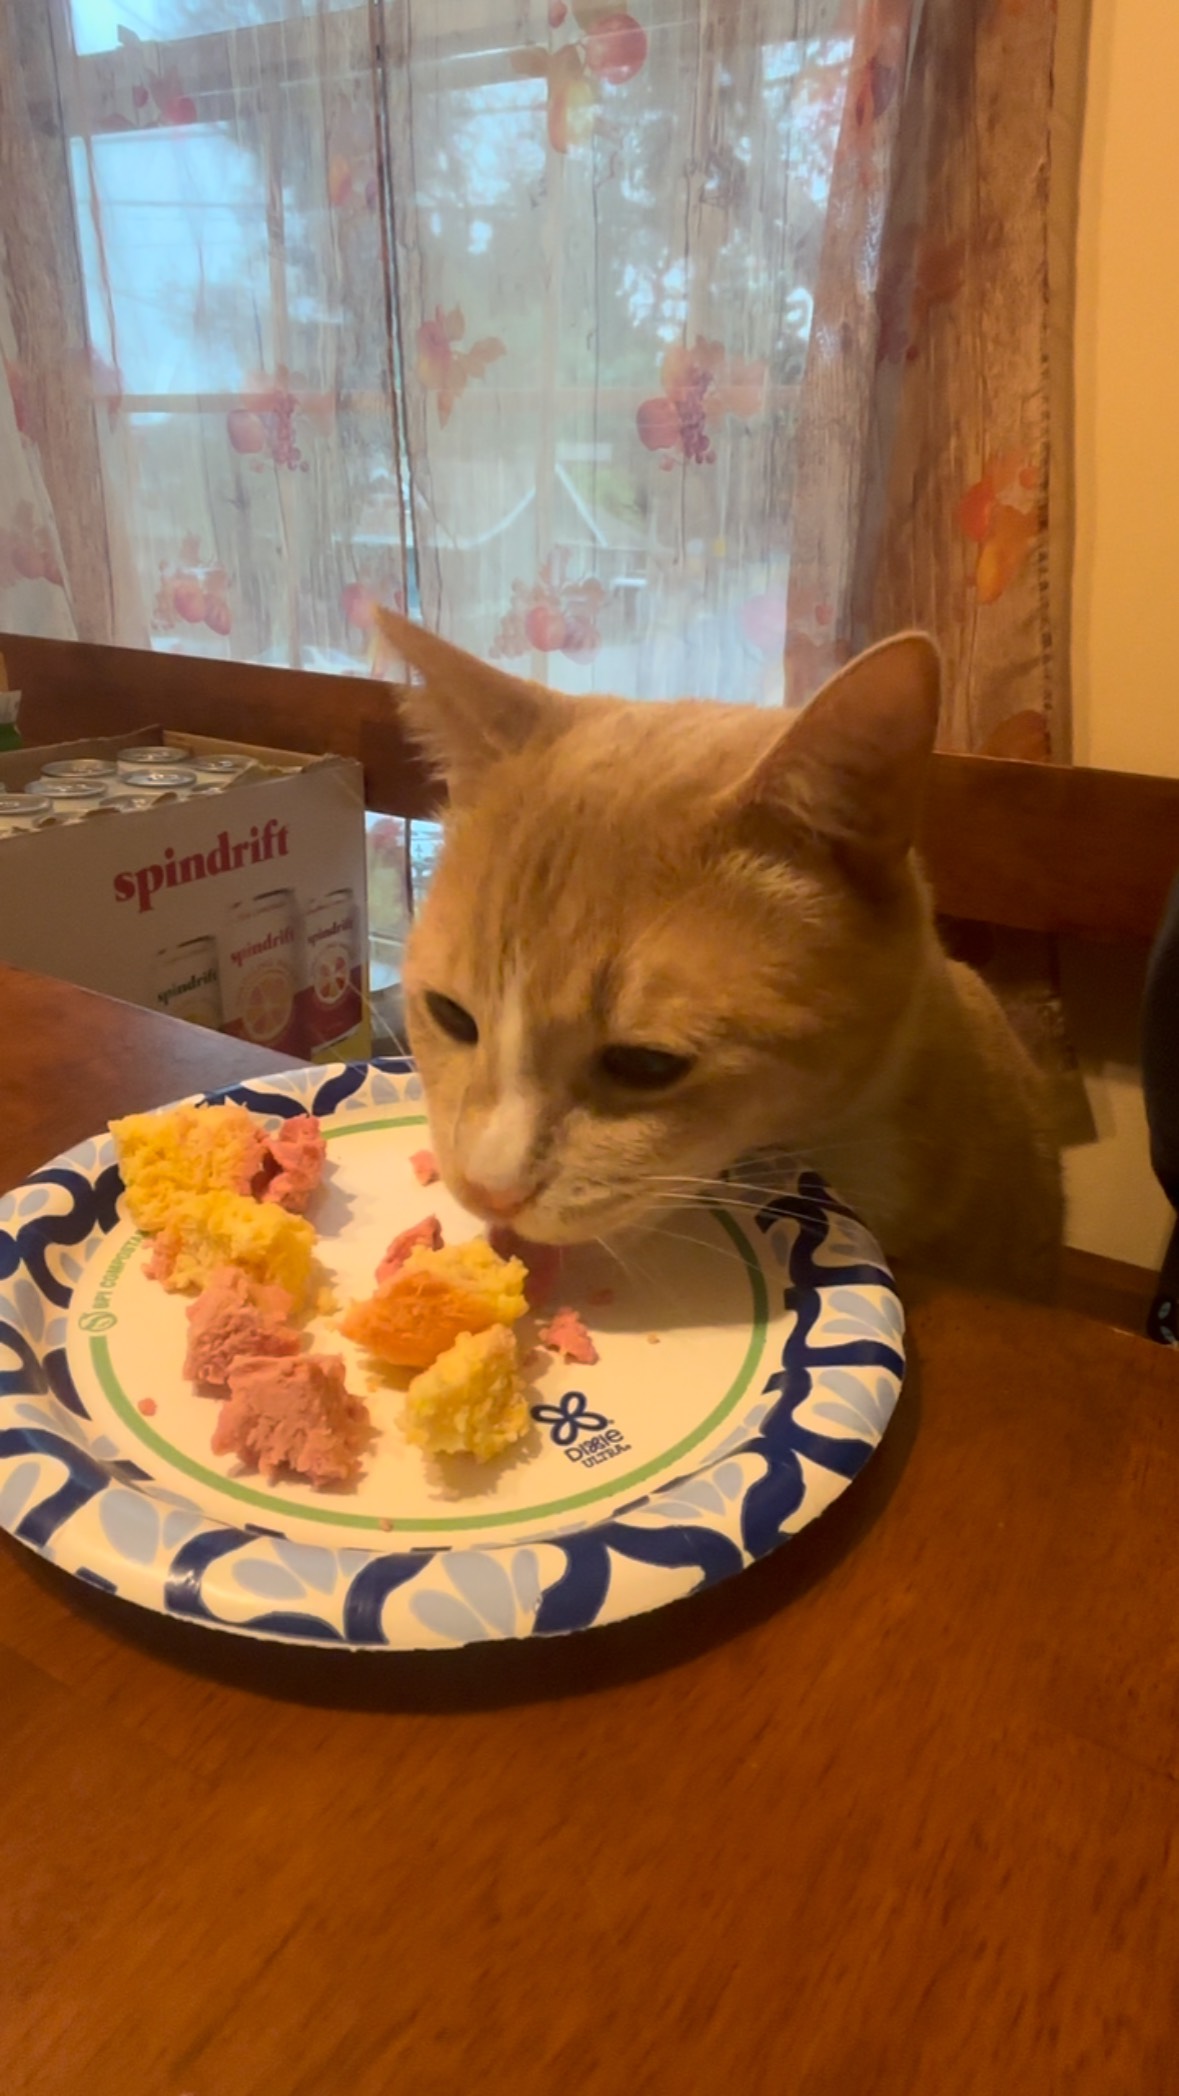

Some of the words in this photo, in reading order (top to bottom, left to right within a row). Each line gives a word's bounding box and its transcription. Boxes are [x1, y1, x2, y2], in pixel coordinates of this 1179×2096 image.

[113, 818, 290, 913] spindrift
[231, 925, 296, 967] spindrift
[157, 969, 218, 1005] spindrift
